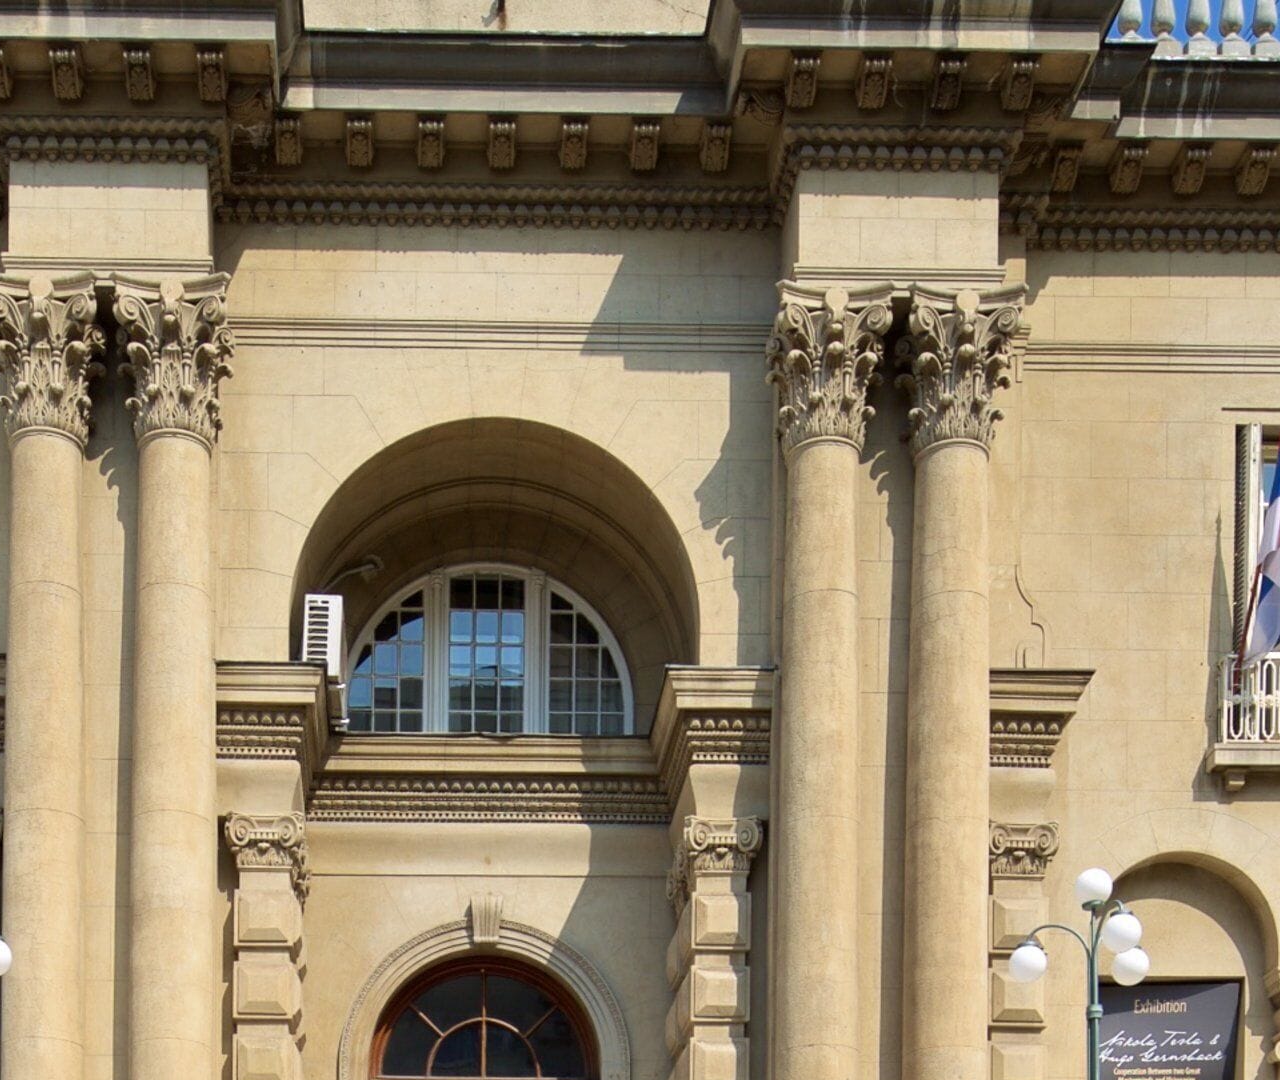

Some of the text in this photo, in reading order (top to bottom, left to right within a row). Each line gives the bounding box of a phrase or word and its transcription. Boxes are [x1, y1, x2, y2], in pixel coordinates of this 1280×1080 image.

[1133, 999, 1187, 1014] Exhibition
[1099, 1030, 1157, 1047] Nikola
[1160, 1030, 1203, 1046] Tesla
